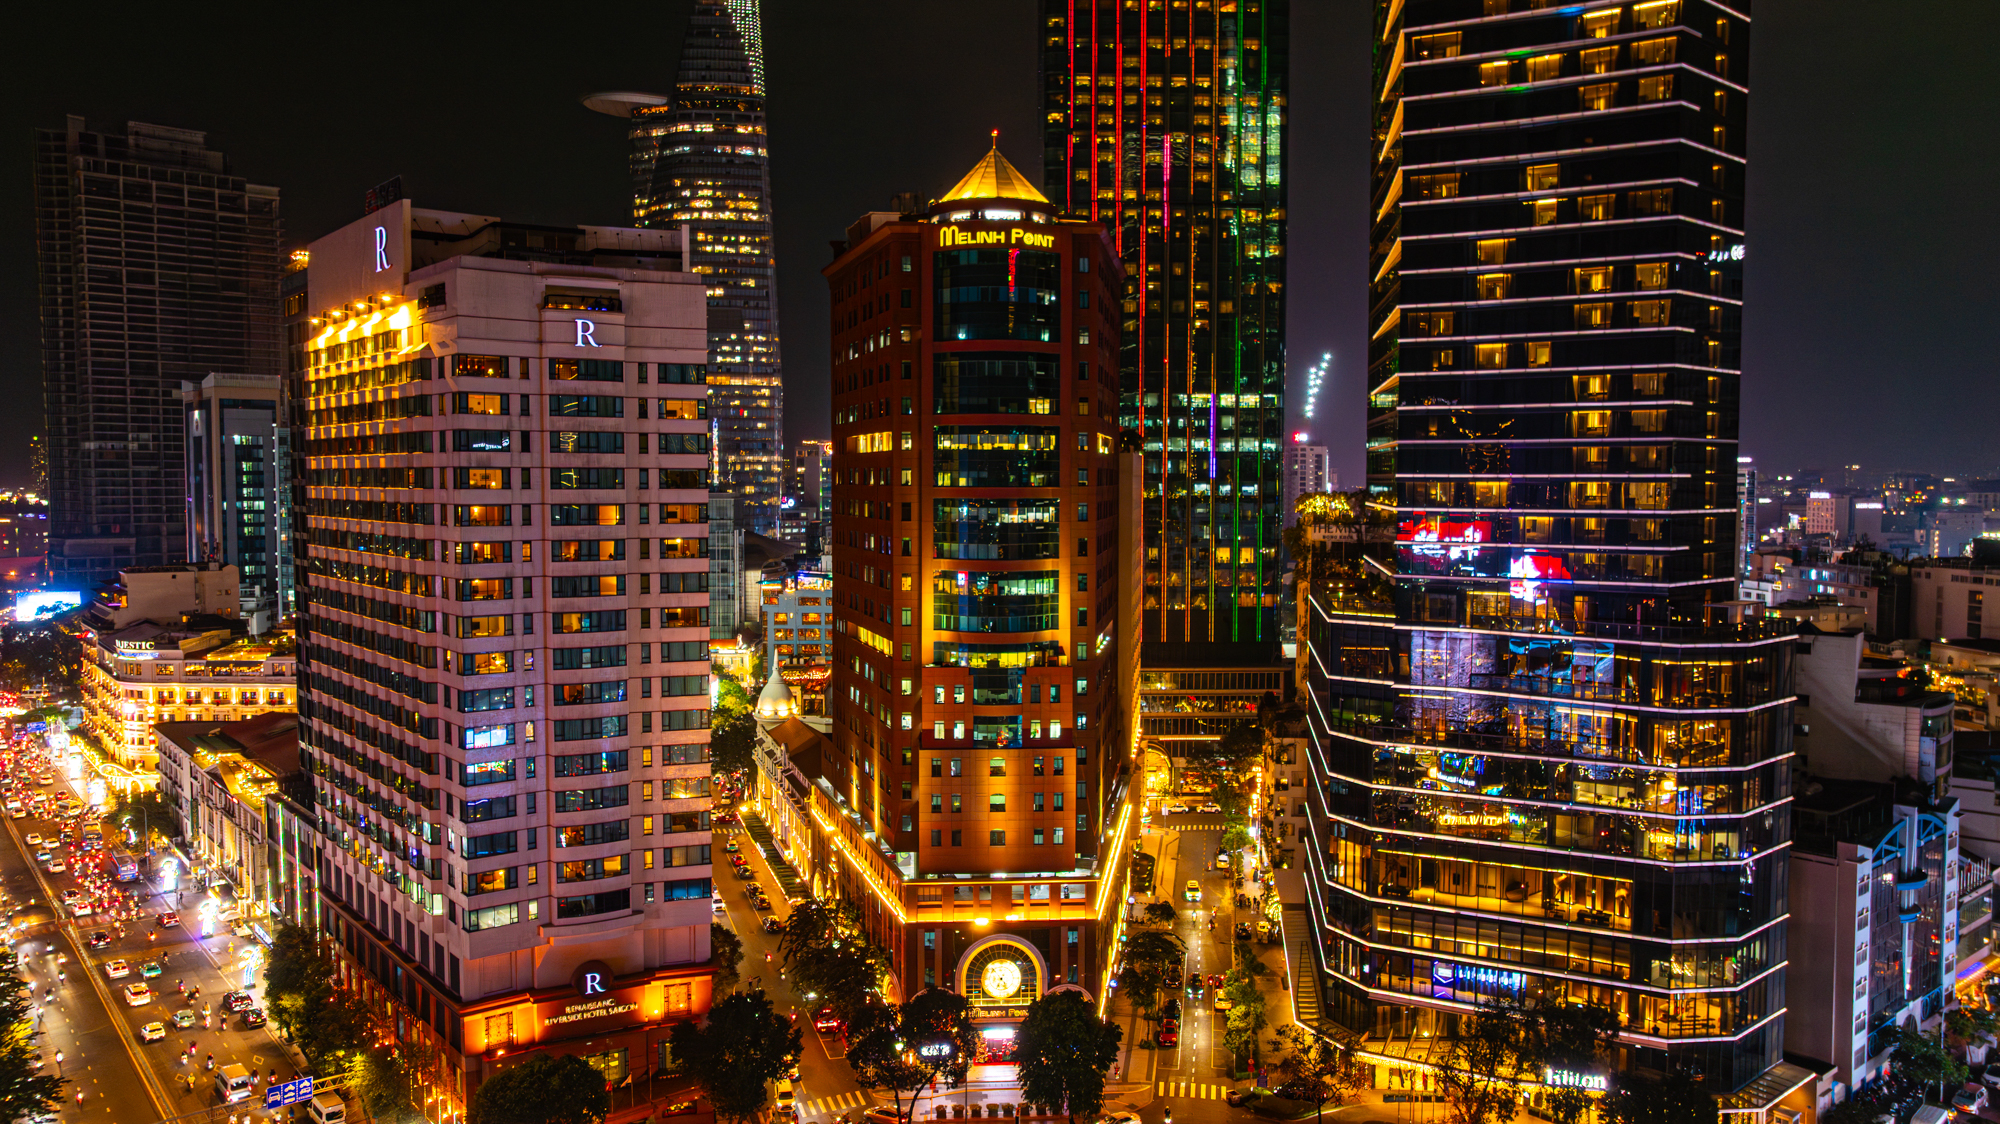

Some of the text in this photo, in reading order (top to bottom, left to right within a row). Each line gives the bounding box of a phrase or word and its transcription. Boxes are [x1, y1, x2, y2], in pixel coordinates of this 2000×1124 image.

[939, 225, 1055, 248] MELINH POINT
[375, 226, 392, 273] R
[574, 318, 602, 348] R
[585, 973, 606, 995] R
[544, 1002, 639, 1026] RIVERSIDE HOTEL SAIGON
[565, 998, 616, 1014] RENAISSANC
[1008, 1008, 1029, 1017] POIN
